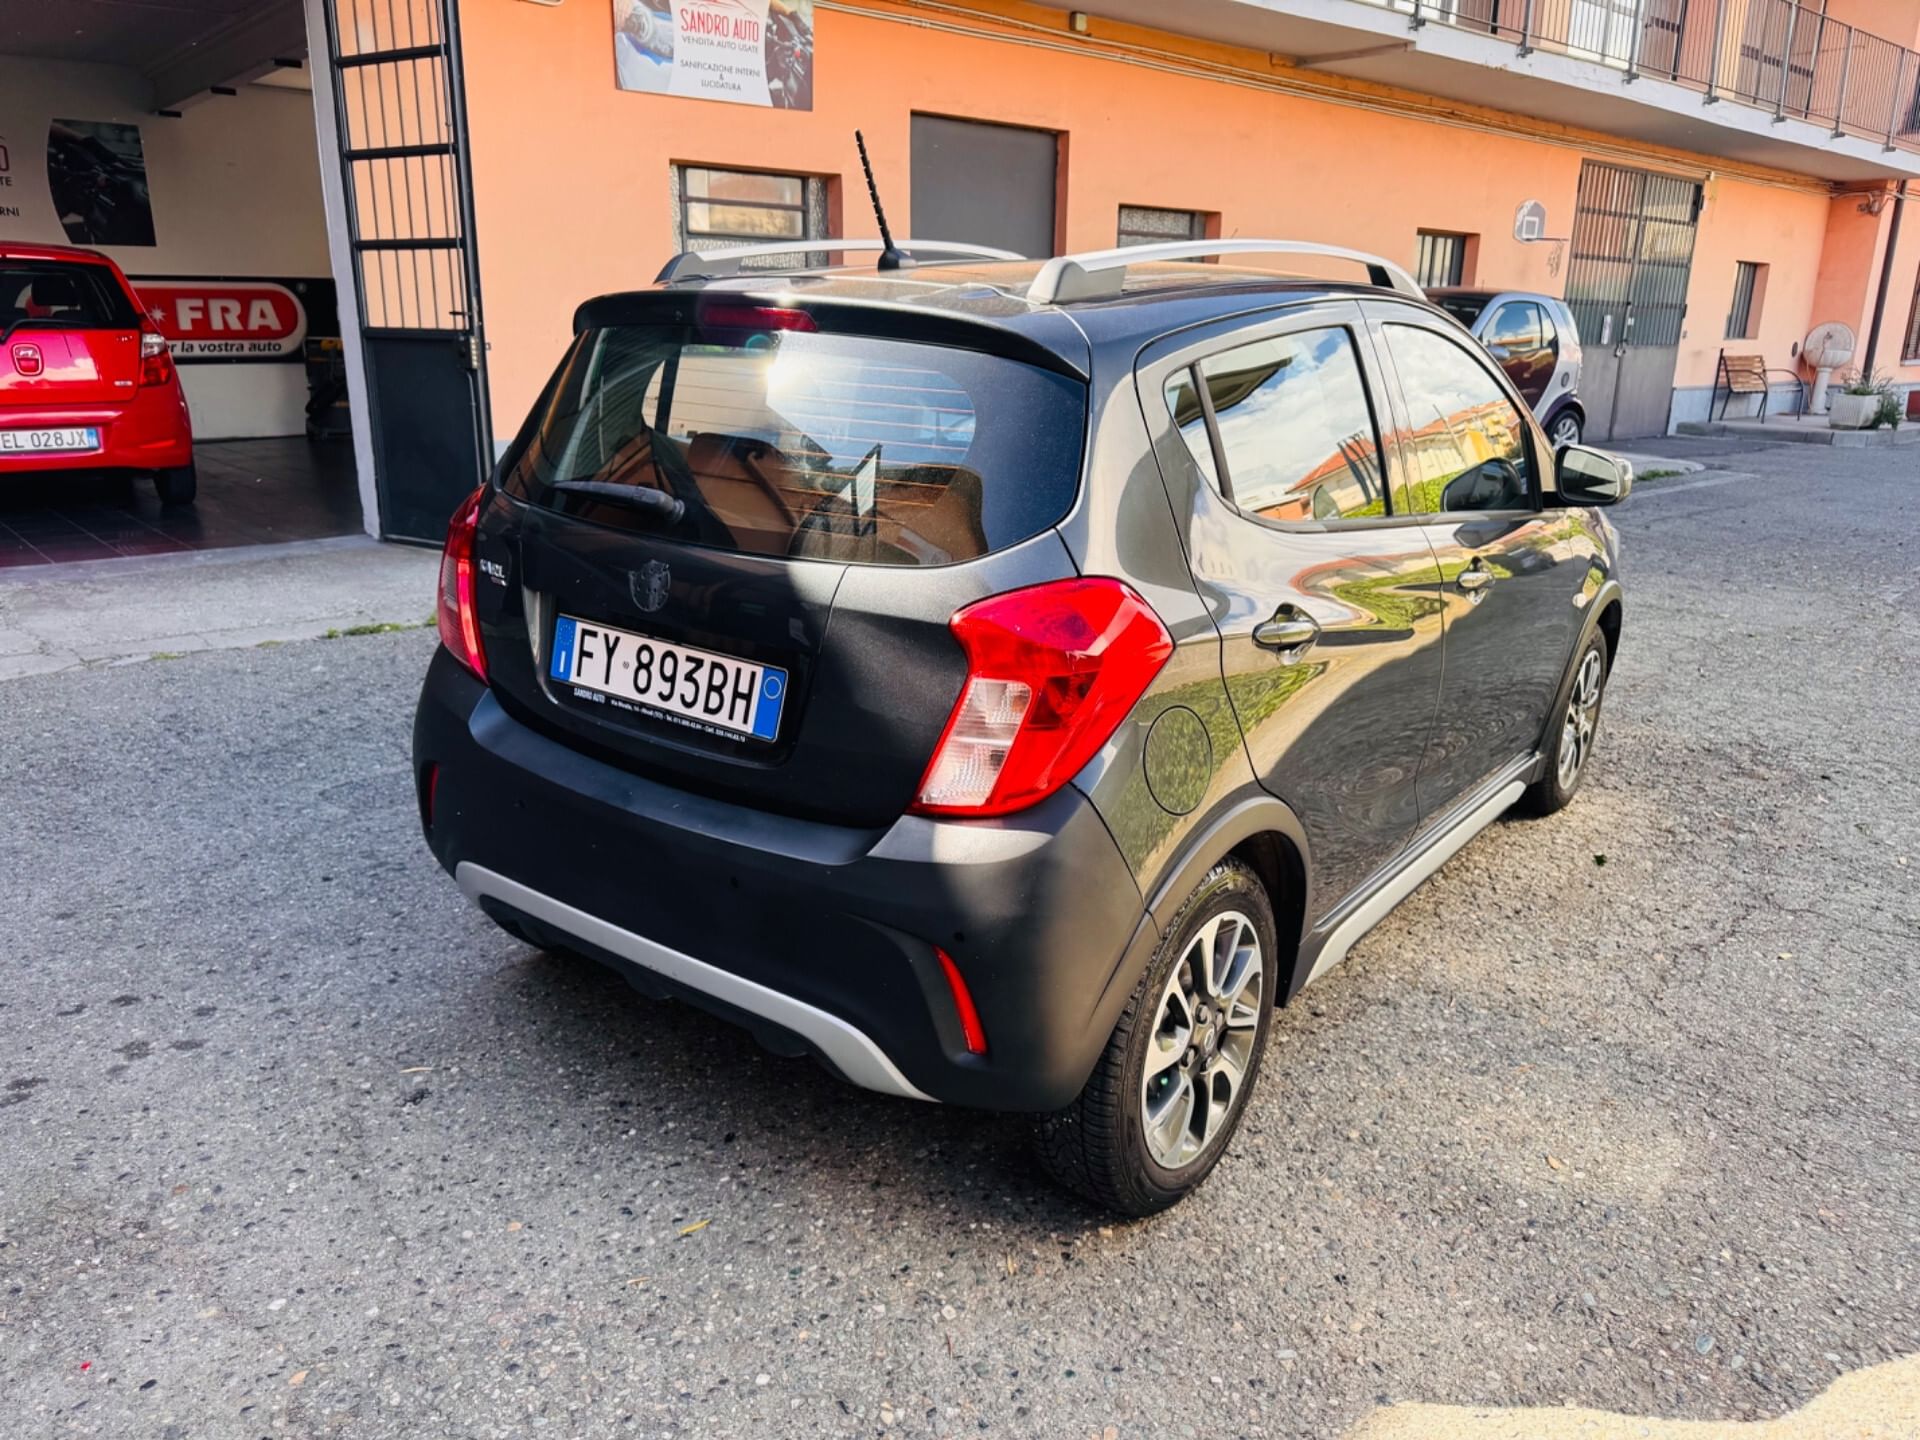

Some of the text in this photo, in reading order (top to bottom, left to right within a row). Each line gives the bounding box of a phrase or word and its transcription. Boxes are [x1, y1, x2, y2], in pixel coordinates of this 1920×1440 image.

[680, 8, 759, 42] SANDRO AUTO
[682, 35, 758, 54] VENDITA AUTO USATE
[680, 59, 760, 77] SANIFICAZIONE INTERNI
[701, 80, 741, 91] LUCIDATURA
[176, 298, 282, 331] FRA
[181, 340, 194, 353] la
[199, 342, 245, 353] vostra
[248, 342, 282, 353] auto
[1, 433, 24, 449] EL
[576, 628, 621, 685] FY
[633, 644, 757, 725] 893BH
